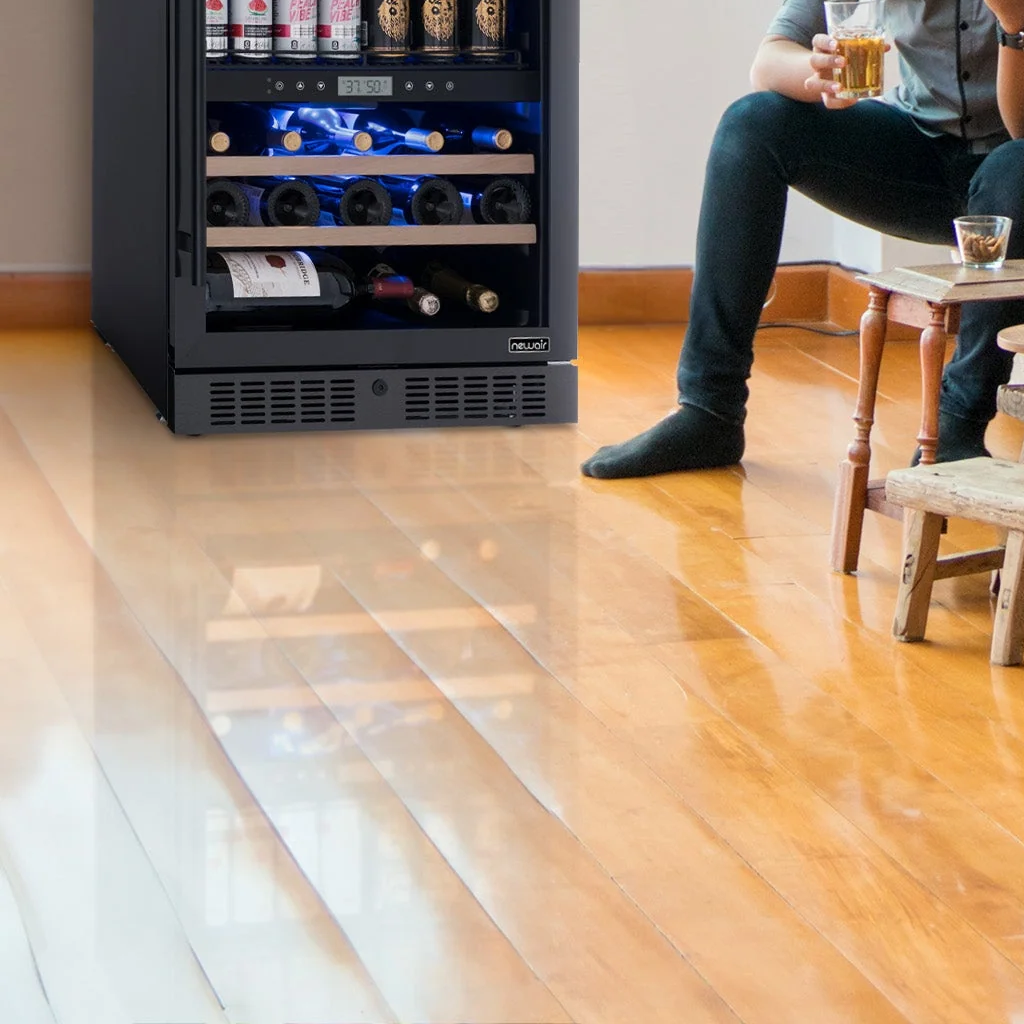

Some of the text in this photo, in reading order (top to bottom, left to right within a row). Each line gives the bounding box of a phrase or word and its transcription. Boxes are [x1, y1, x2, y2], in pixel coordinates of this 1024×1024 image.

[289, 7, 312, 23] VIBE
[330, 8, 353, 23] VIBE
[346, 79, 361, 94] 37
[511, 339, 547, 350] newair
